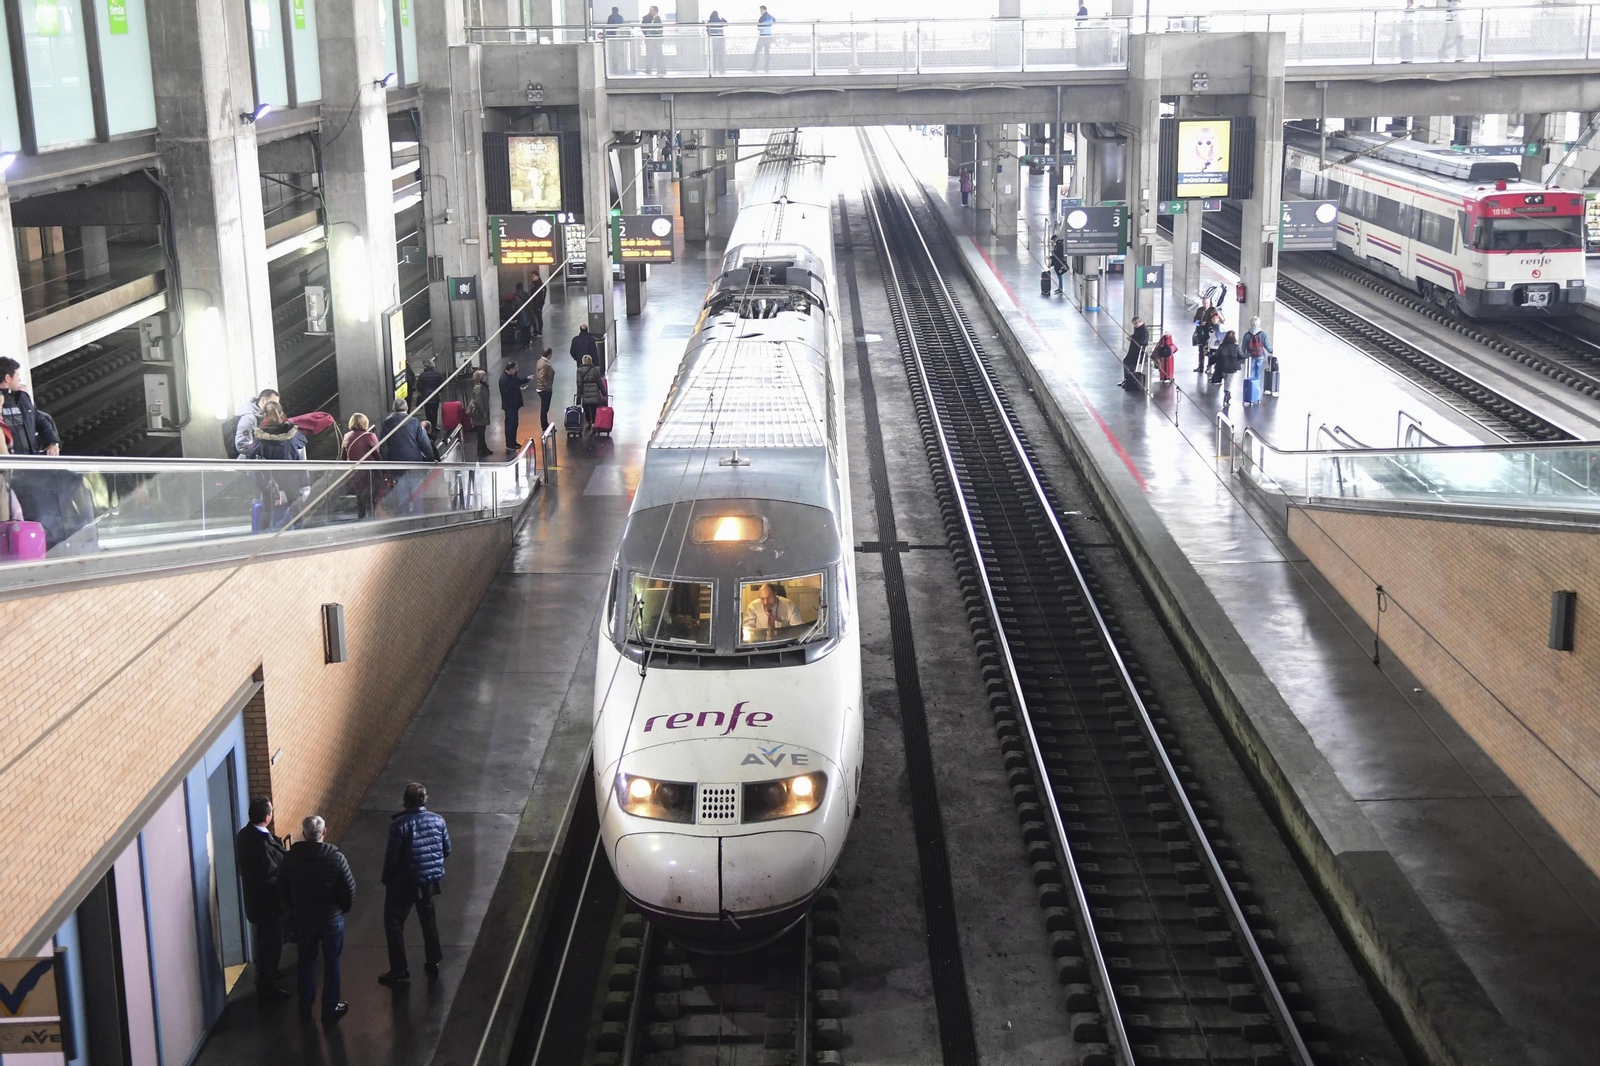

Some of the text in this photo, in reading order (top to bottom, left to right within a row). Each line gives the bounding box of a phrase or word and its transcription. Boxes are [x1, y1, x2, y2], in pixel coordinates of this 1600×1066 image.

[1041, 157, 1046, 165] 3
[655, 163, 660, 171] 2
[1204, 201, 1211, 210] 4
[1113, 216, 1120, 227] 3
[1283, 212, 1291, 222] 4
[499, 227, 507, 237] 1
[619, 226, 626, 236] 2
[1520, 256, 1551, 267] renfe
[643, 701, 773, 735] renfe
[740, 744, 808, 767] AVE
[21, 1029, 61, 1044] AVE
